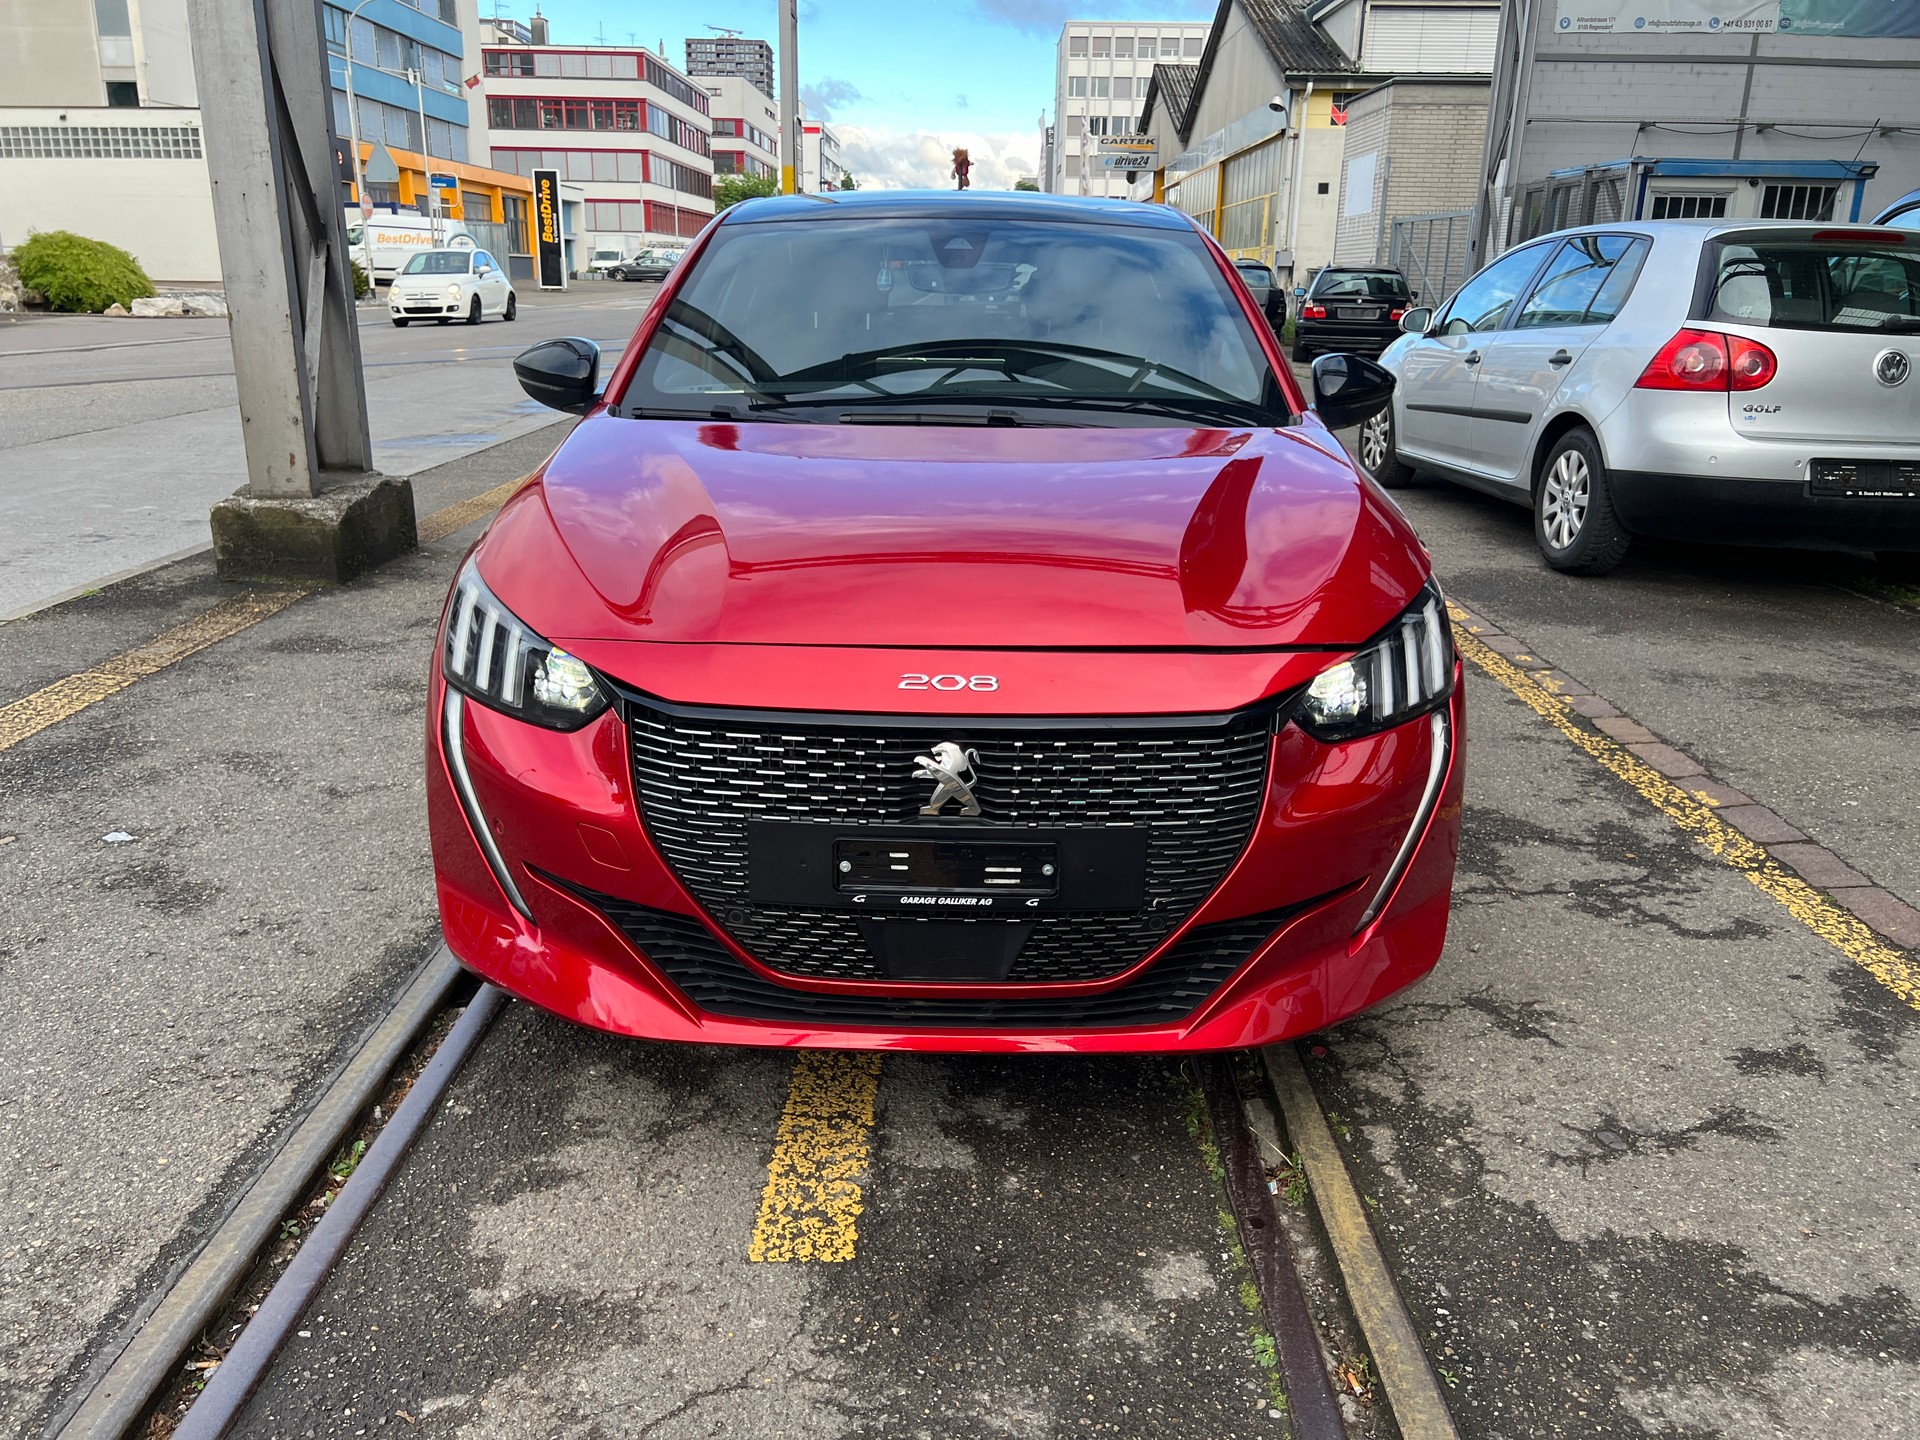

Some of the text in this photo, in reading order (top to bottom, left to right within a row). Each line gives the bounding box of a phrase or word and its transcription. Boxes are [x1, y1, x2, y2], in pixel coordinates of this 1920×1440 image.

[1723, 20, 1773, 28] +41 43 931 00 87
[538, 179, 554, 243] BestDrive
[377, 232, 433, 244] BestDrive
[1743, 404, 1782, 414] GOLF
[897, 673, 1000, 692] 208
[900, 896, 937, 905] GARAGE
[937, 897, 978, 906] GALLIKER
[978, 898, 993, 906] AG
